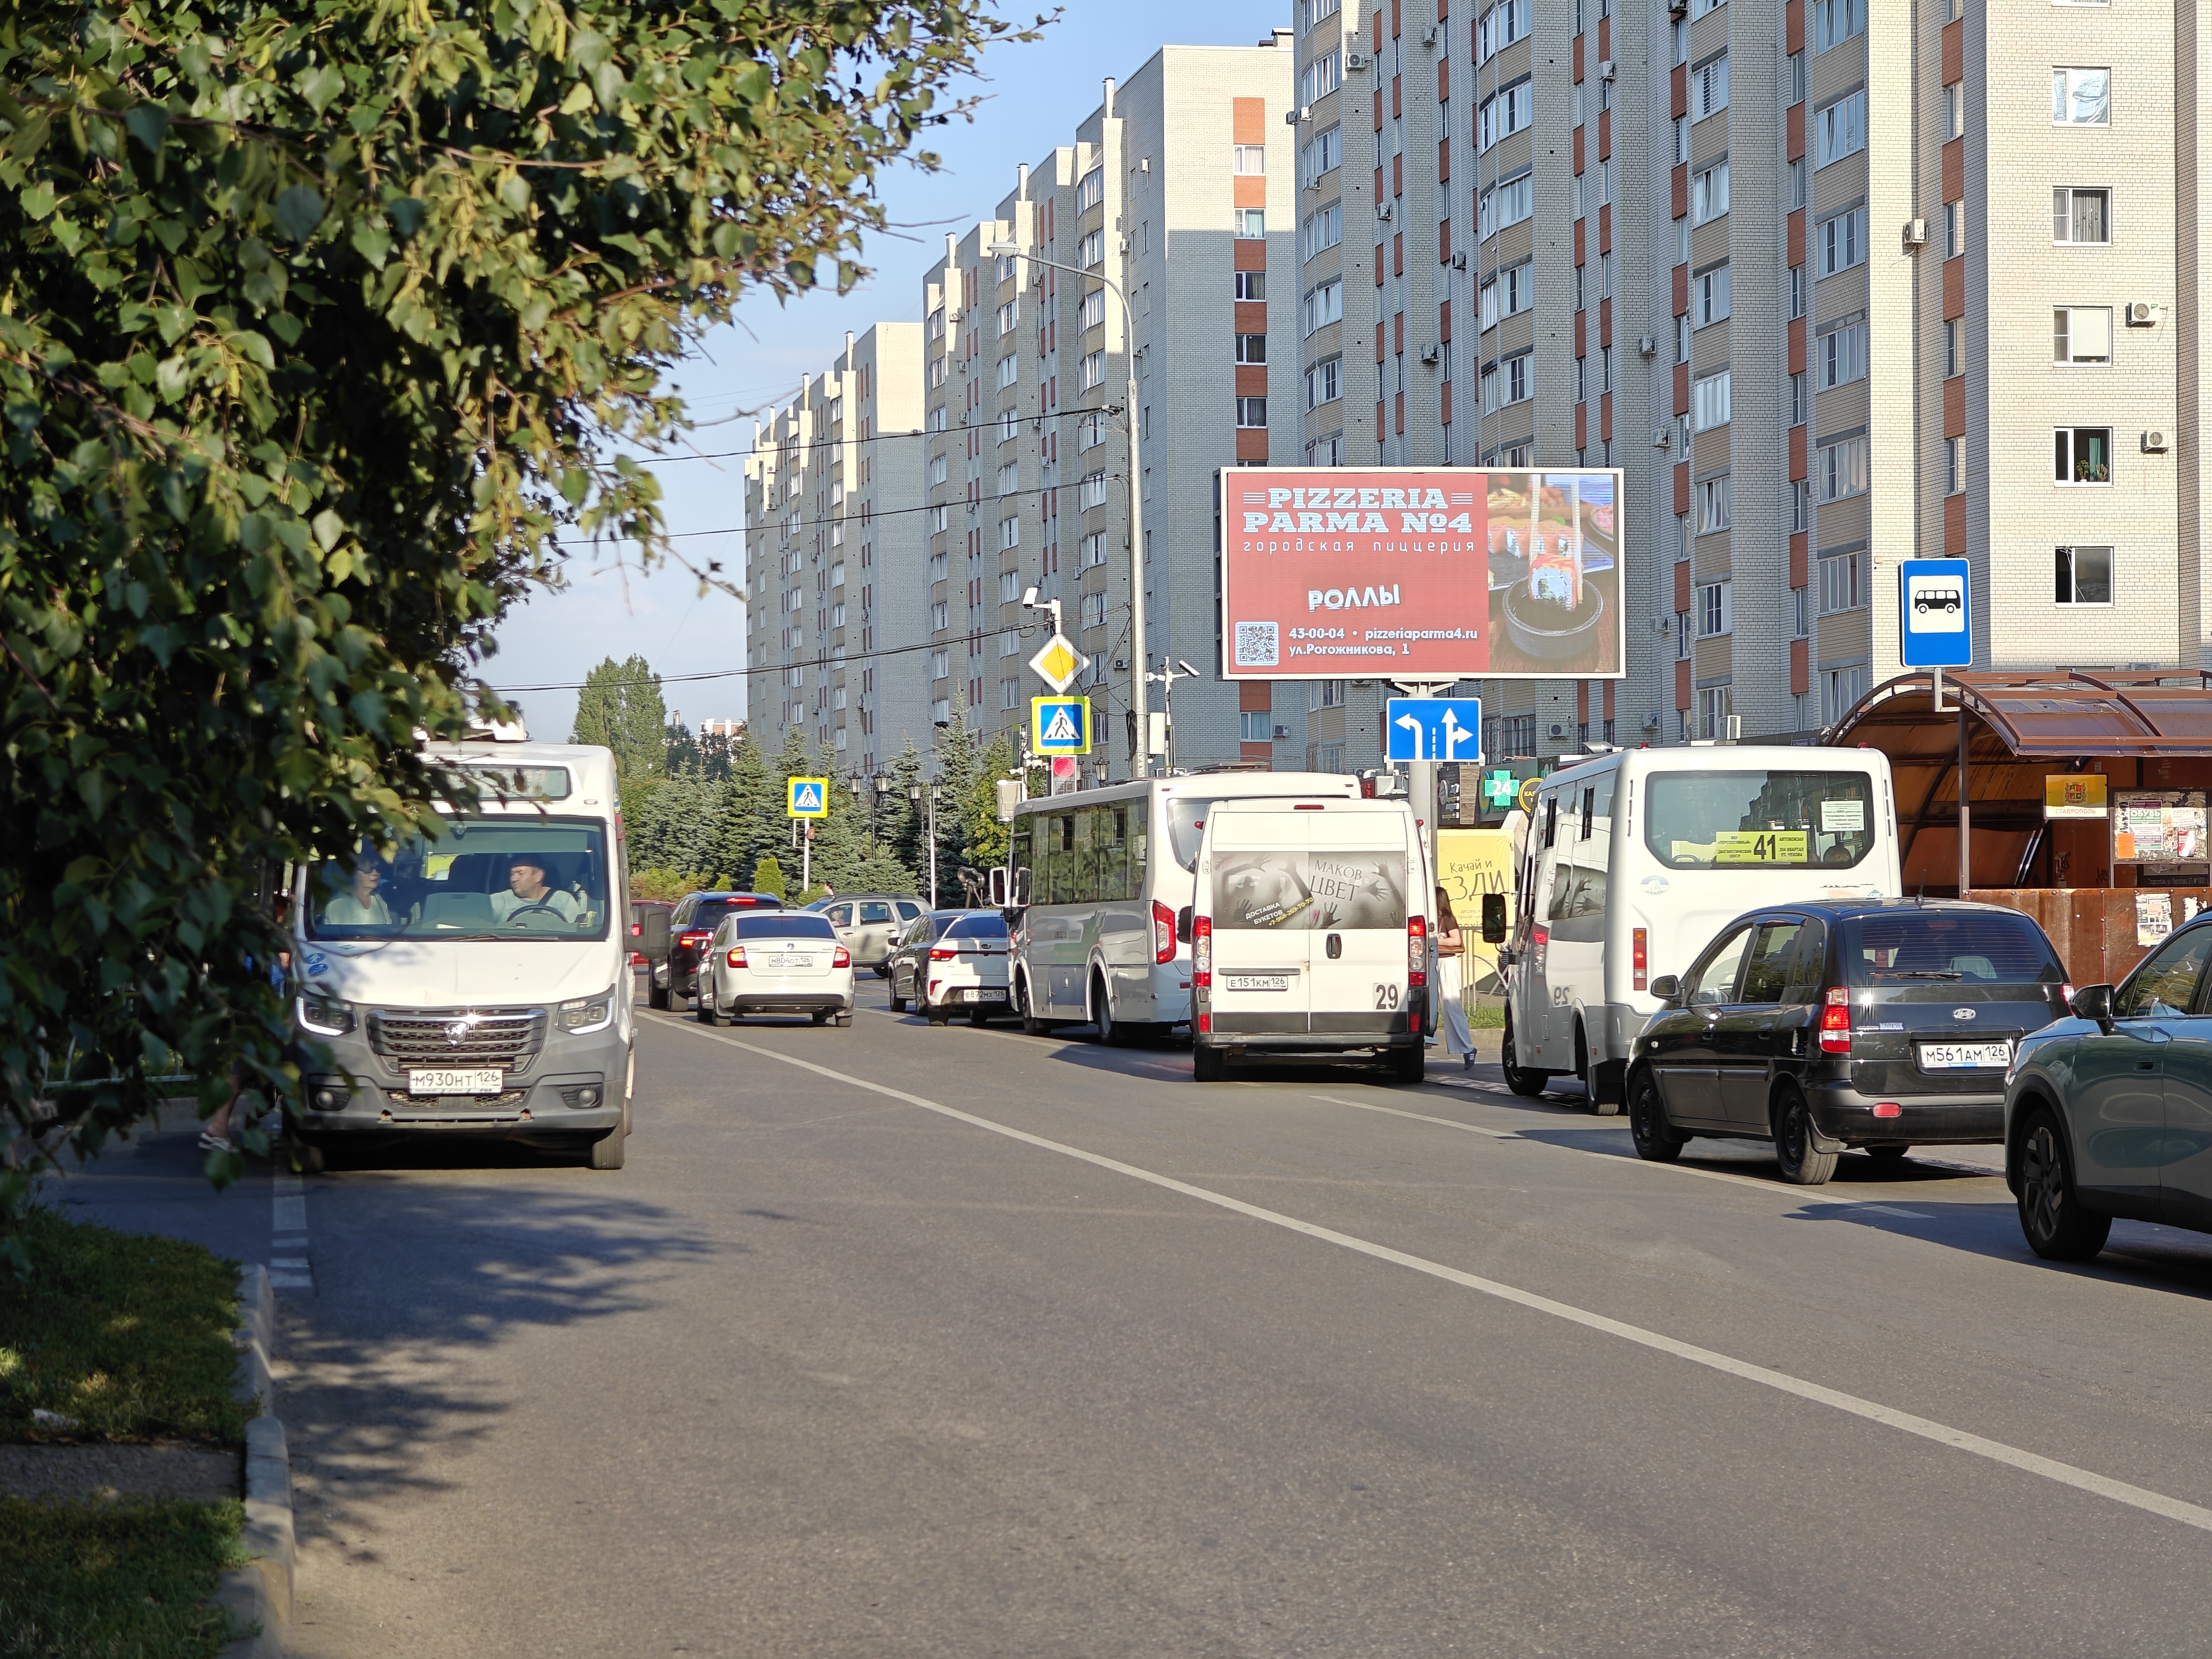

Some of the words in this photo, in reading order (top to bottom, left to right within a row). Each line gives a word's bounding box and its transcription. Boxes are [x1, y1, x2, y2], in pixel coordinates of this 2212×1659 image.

[1268, 488, 1448, 509] PIZZERIA
[1243, 512, 1389, 533] PARMA
[1243, 538, 1354, 555] городская
[1373, 541, 1474, 555] пиццерия
[1288, 628, 1345, 639] 43-00-04
[1365, 627, 1478, 641] pizzeriaparma4.ru
[1288, 644, 1396, 657] ул.Рогожникова,
[1401, 644, 1409, 655] 1
[1492, 781, 1512, 796] 24
[1754, 835, 1776, 859] 41
[1314, 860, 1362, 880] МАКОВ
[1450, 858, 1481, 873] Качай
[1310, 876, 1360, 902] ЦВЕТ
[1246, 902, 1281, 920] ДОСТАВКА
[1253, 910, 1283, 925] БУКЕТОВ
[1376, 984, 1398, 1010] 29
[1985, 1046, 2005, 1057] 126
[477, 1071, 497, 1082] 126
